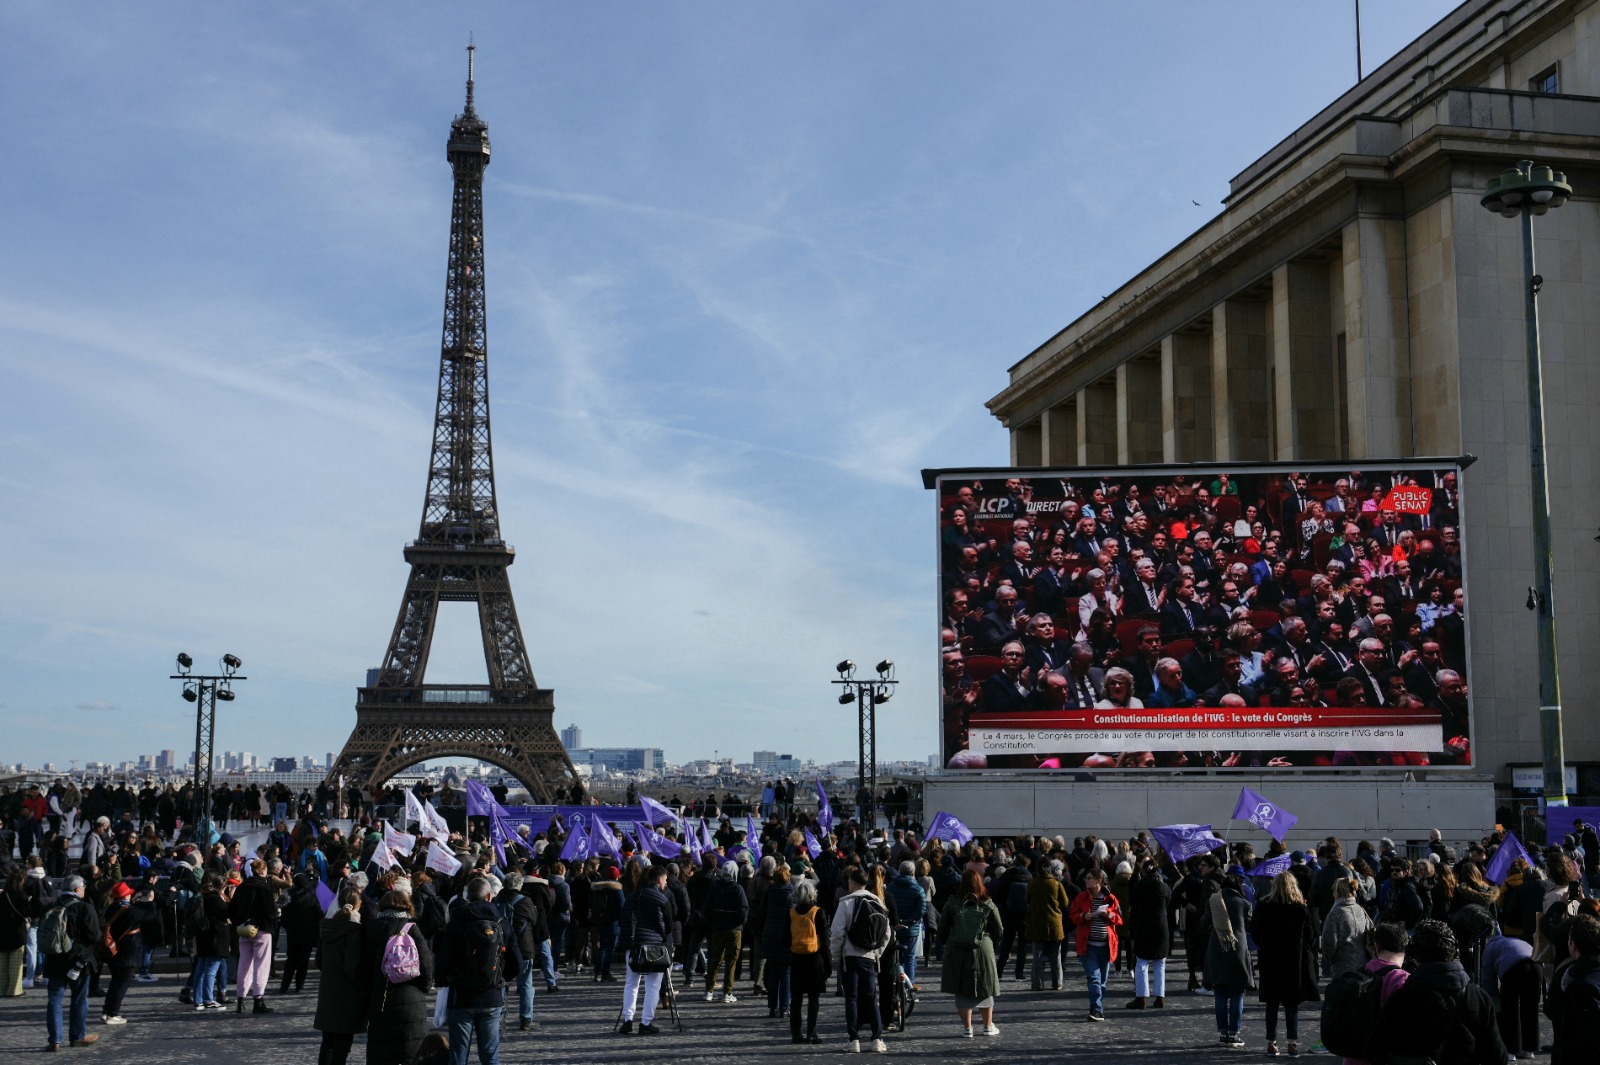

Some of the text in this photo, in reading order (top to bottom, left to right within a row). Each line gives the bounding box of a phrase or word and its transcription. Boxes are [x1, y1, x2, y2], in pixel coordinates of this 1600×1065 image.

[979, 498, 1009, 512] LCP
[1026, 501, 1061, 512] DIRECT
[1094, 714, 1190, 723] Constitutionnalisation
[1192, 713, 1202, 722] de
[1204, 713, 1224, 722] l'IVG
[1232, 713, 1240, 722] le
[1263, 712, 1274, 722] du
[1276, 712, 1312, 724] Congrès
[1038, 732, 1072, 741] Congrès
[1075, 731, 1109, 740] procède
[1158, 731, 1183, 739] projet
